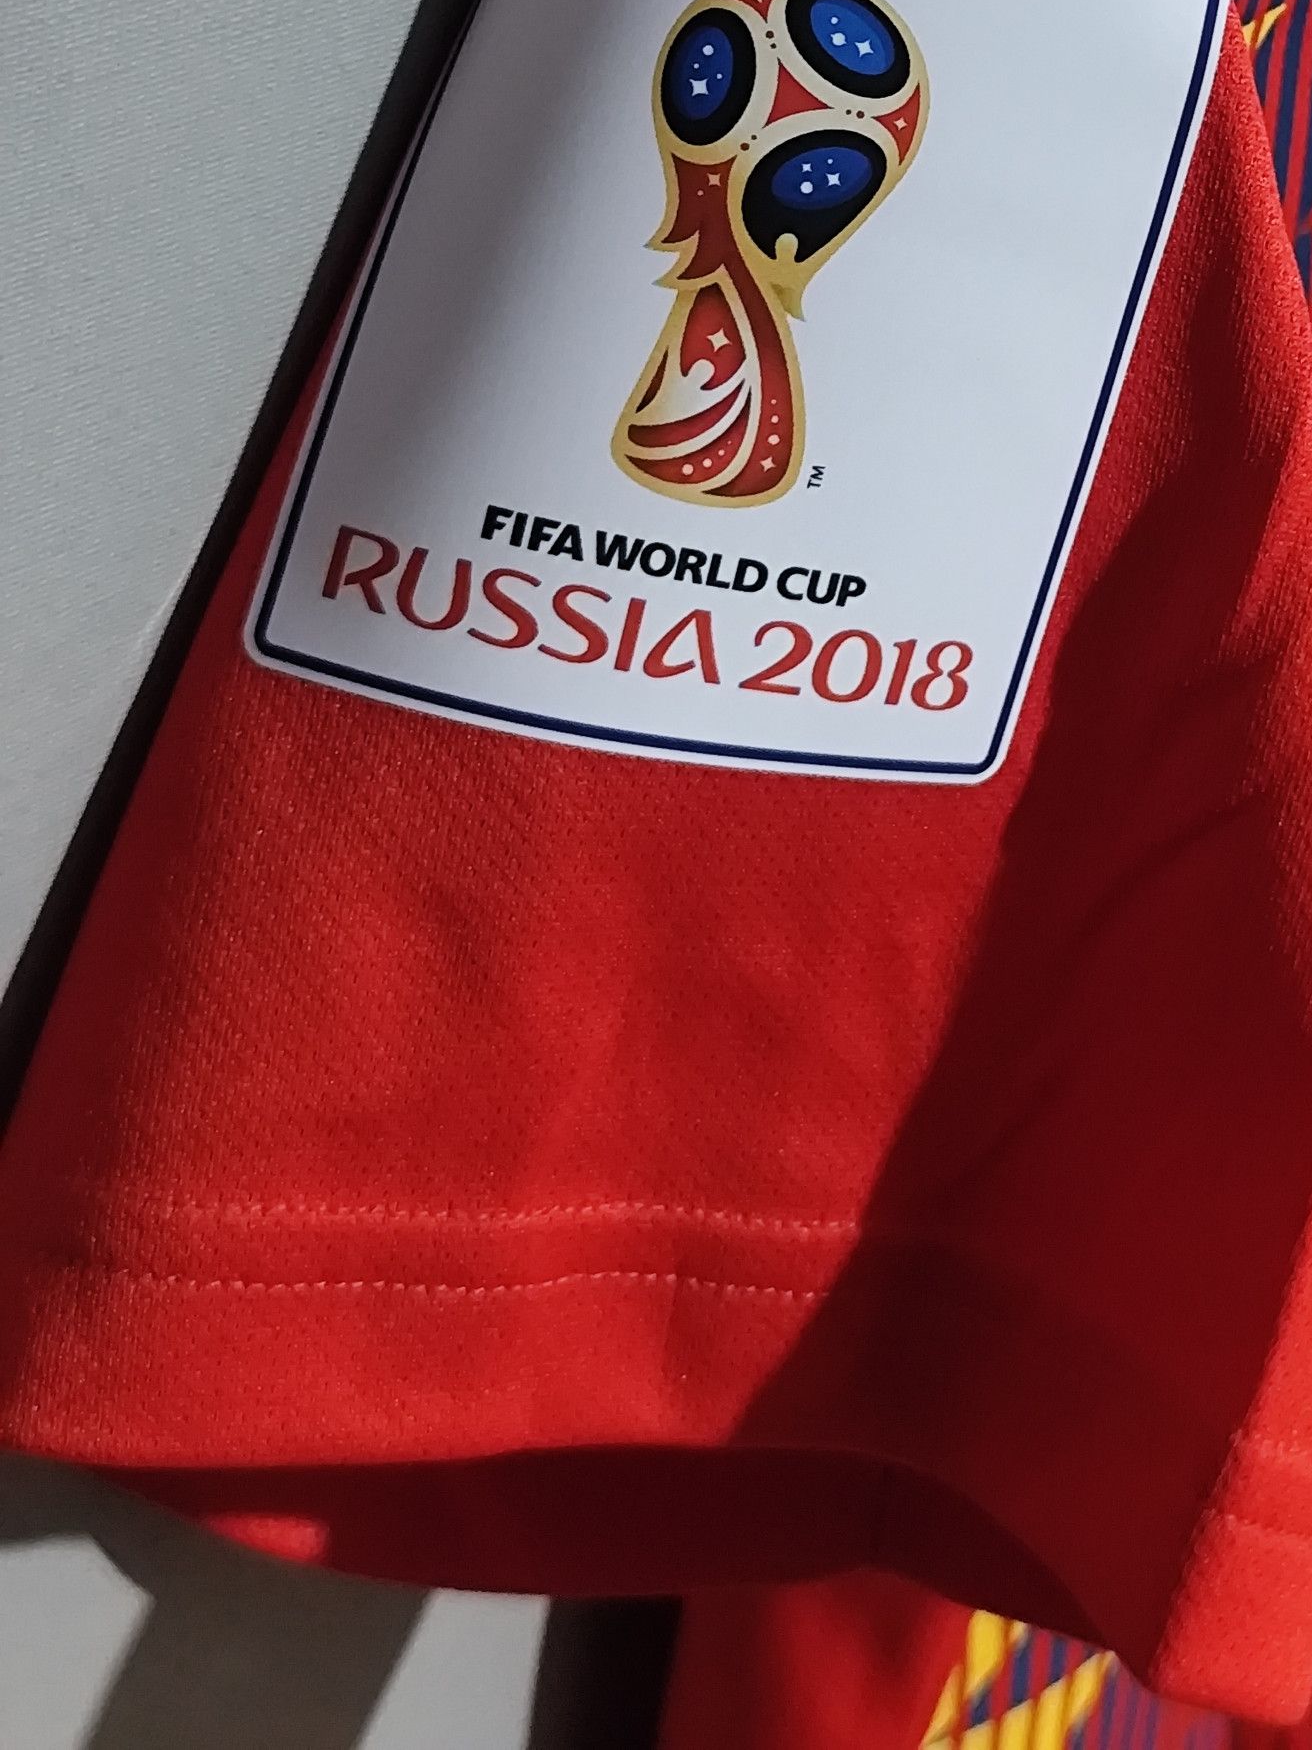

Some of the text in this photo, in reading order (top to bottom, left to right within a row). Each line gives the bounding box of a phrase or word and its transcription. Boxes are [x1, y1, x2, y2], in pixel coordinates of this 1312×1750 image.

[321, 525, 974, 712] RUSSIA 2018
[480, 504, 867, 608] FIFA WORLD CUP
